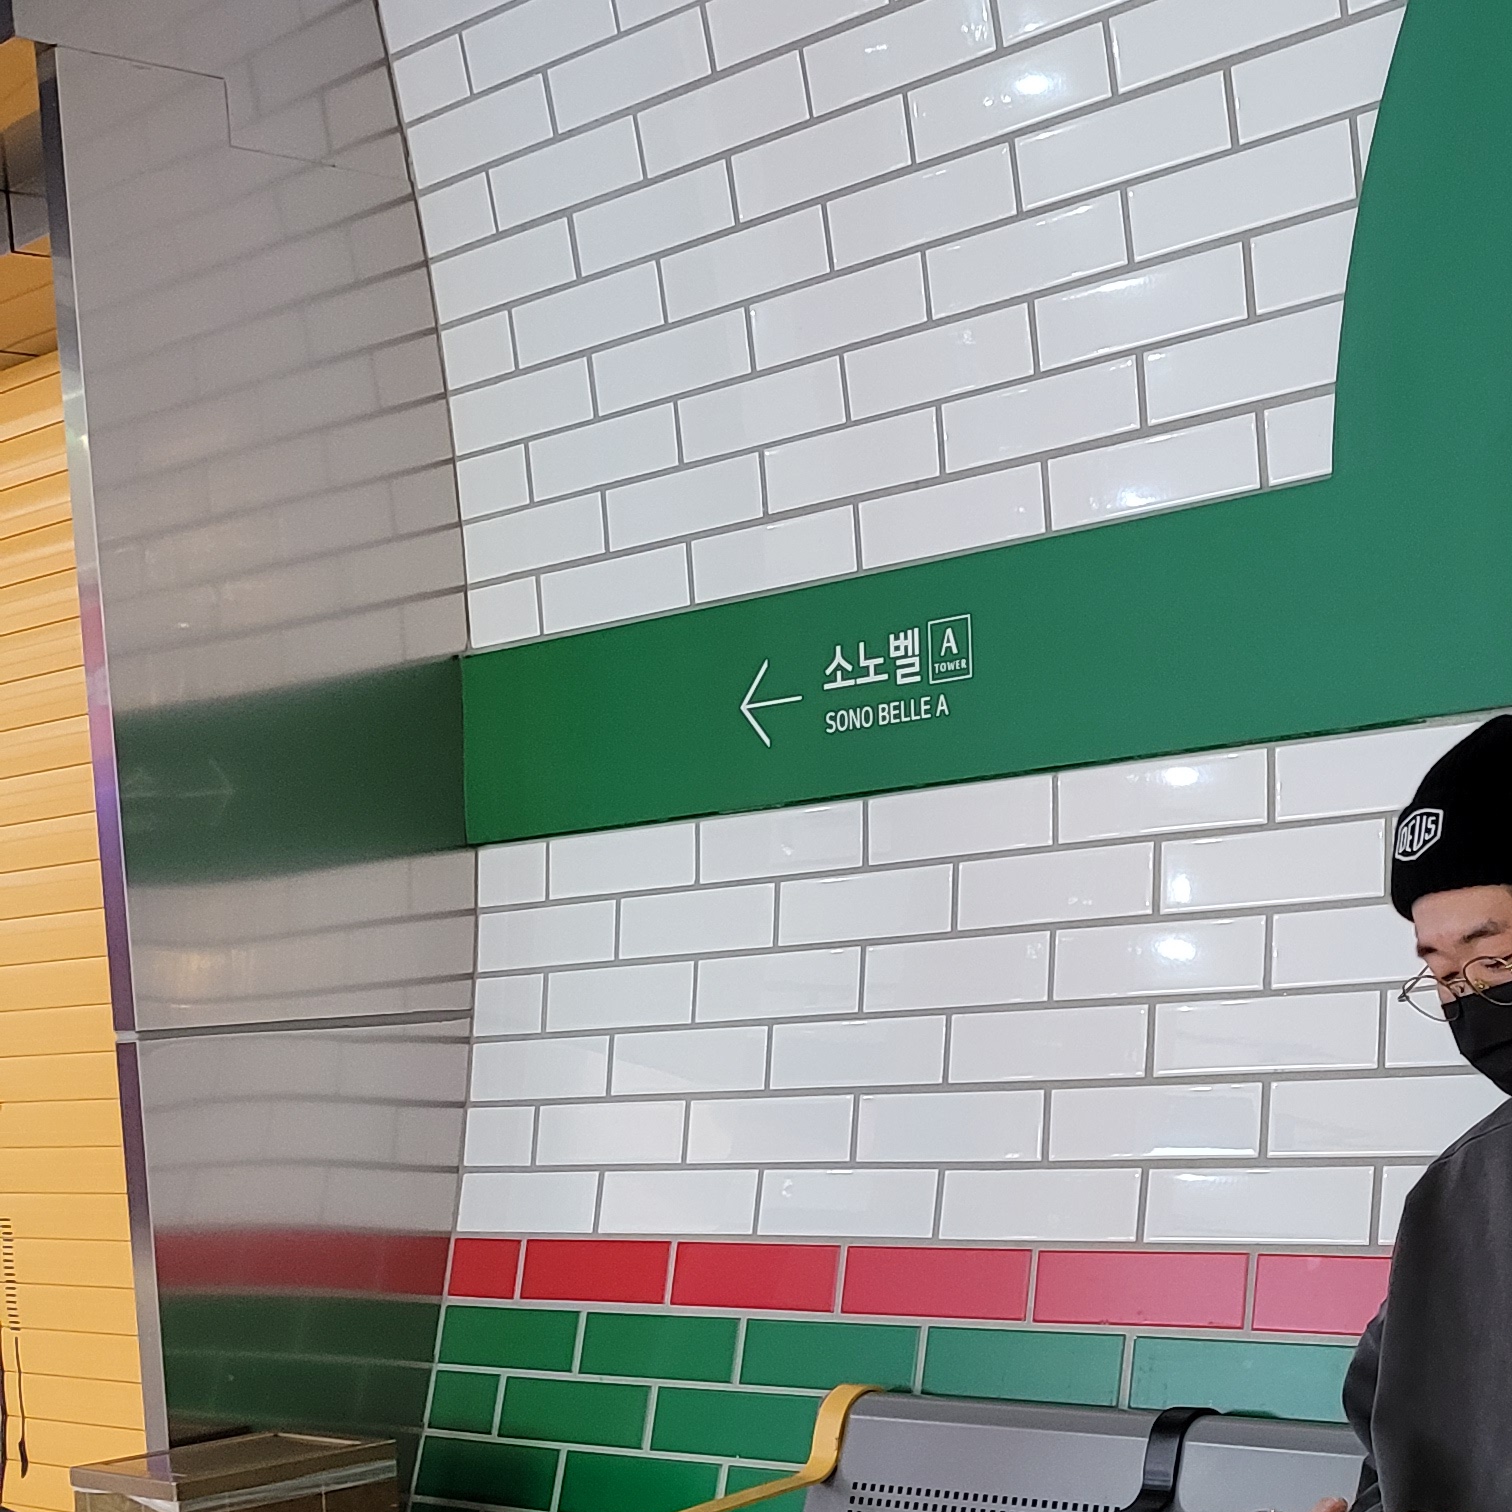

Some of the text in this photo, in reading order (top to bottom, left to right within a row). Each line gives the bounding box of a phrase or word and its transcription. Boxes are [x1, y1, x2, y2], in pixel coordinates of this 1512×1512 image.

[823, 627, 922, 691] 소노벨
[940, 627, 959, 657] A
[933, 658, 967, 674] TOWER
[825, 694, 950, 734] SONO BELLE A
[1398, 815, 1437, 854] DEUS
